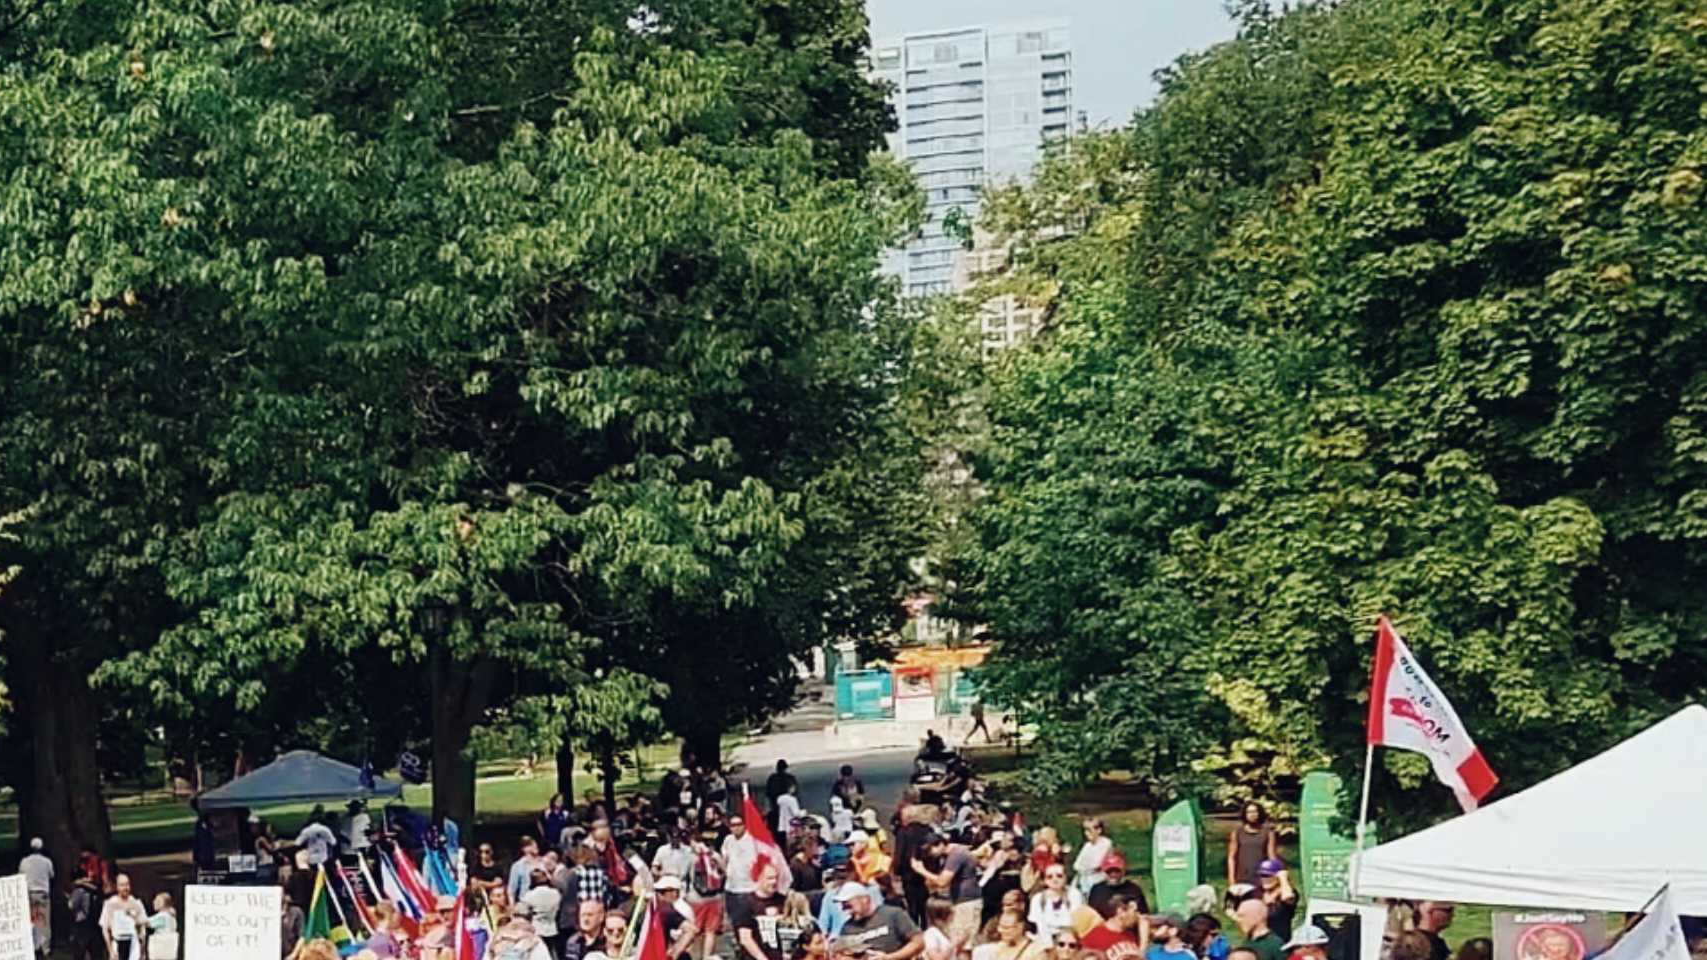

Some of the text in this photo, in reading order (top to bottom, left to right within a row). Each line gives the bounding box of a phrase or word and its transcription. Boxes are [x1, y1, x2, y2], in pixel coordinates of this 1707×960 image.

[192, 891, 275, 910] KEEP THE
[194, 914, 273, 931] KIDS OUT
[205, 933, 230, 947] OF
